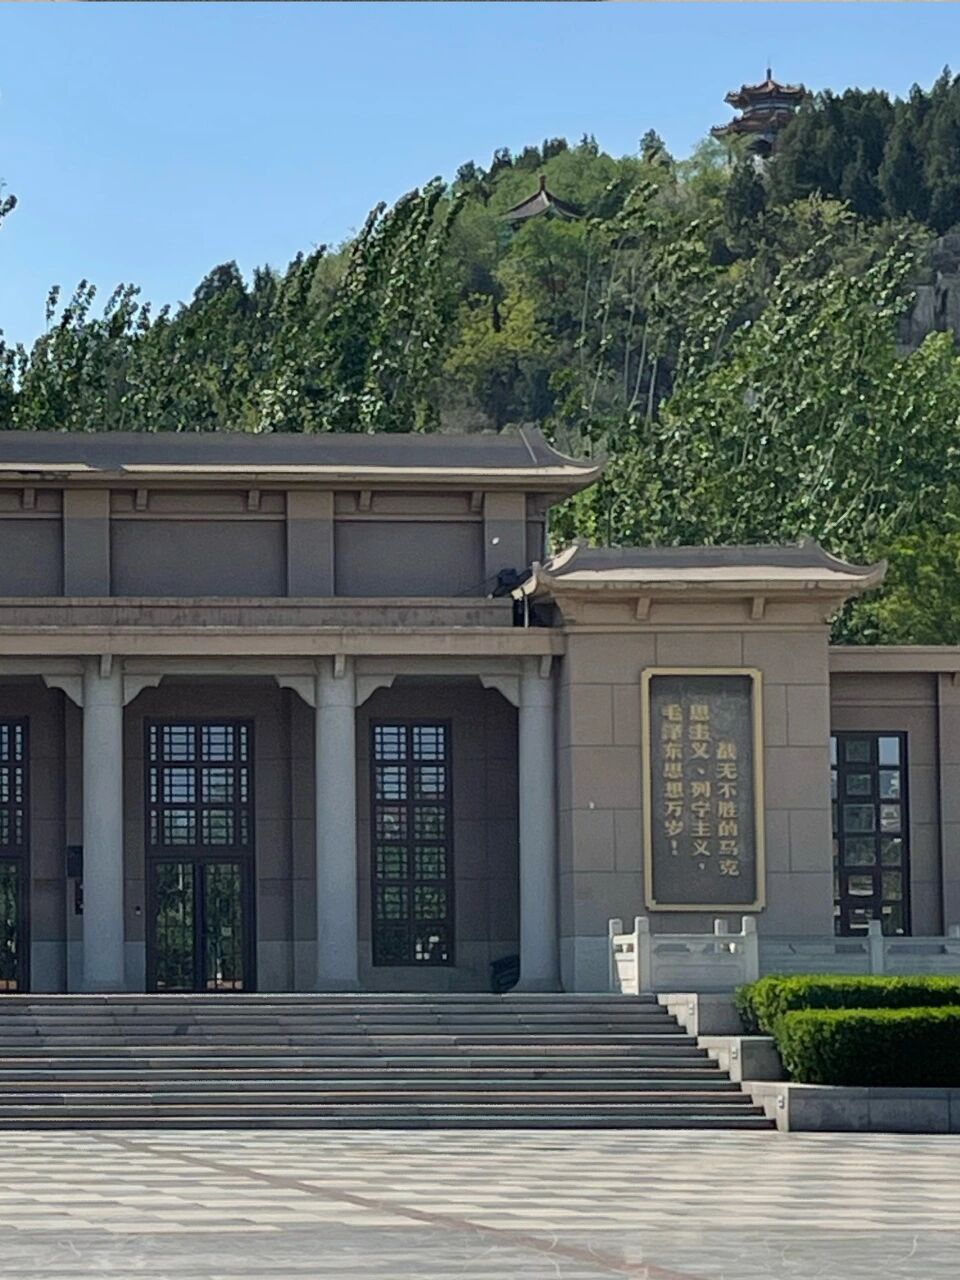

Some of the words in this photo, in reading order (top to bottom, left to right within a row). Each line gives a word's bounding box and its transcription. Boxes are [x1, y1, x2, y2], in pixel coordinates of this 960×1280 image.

[715, 741, 740, 877] 战无不胜的马克
